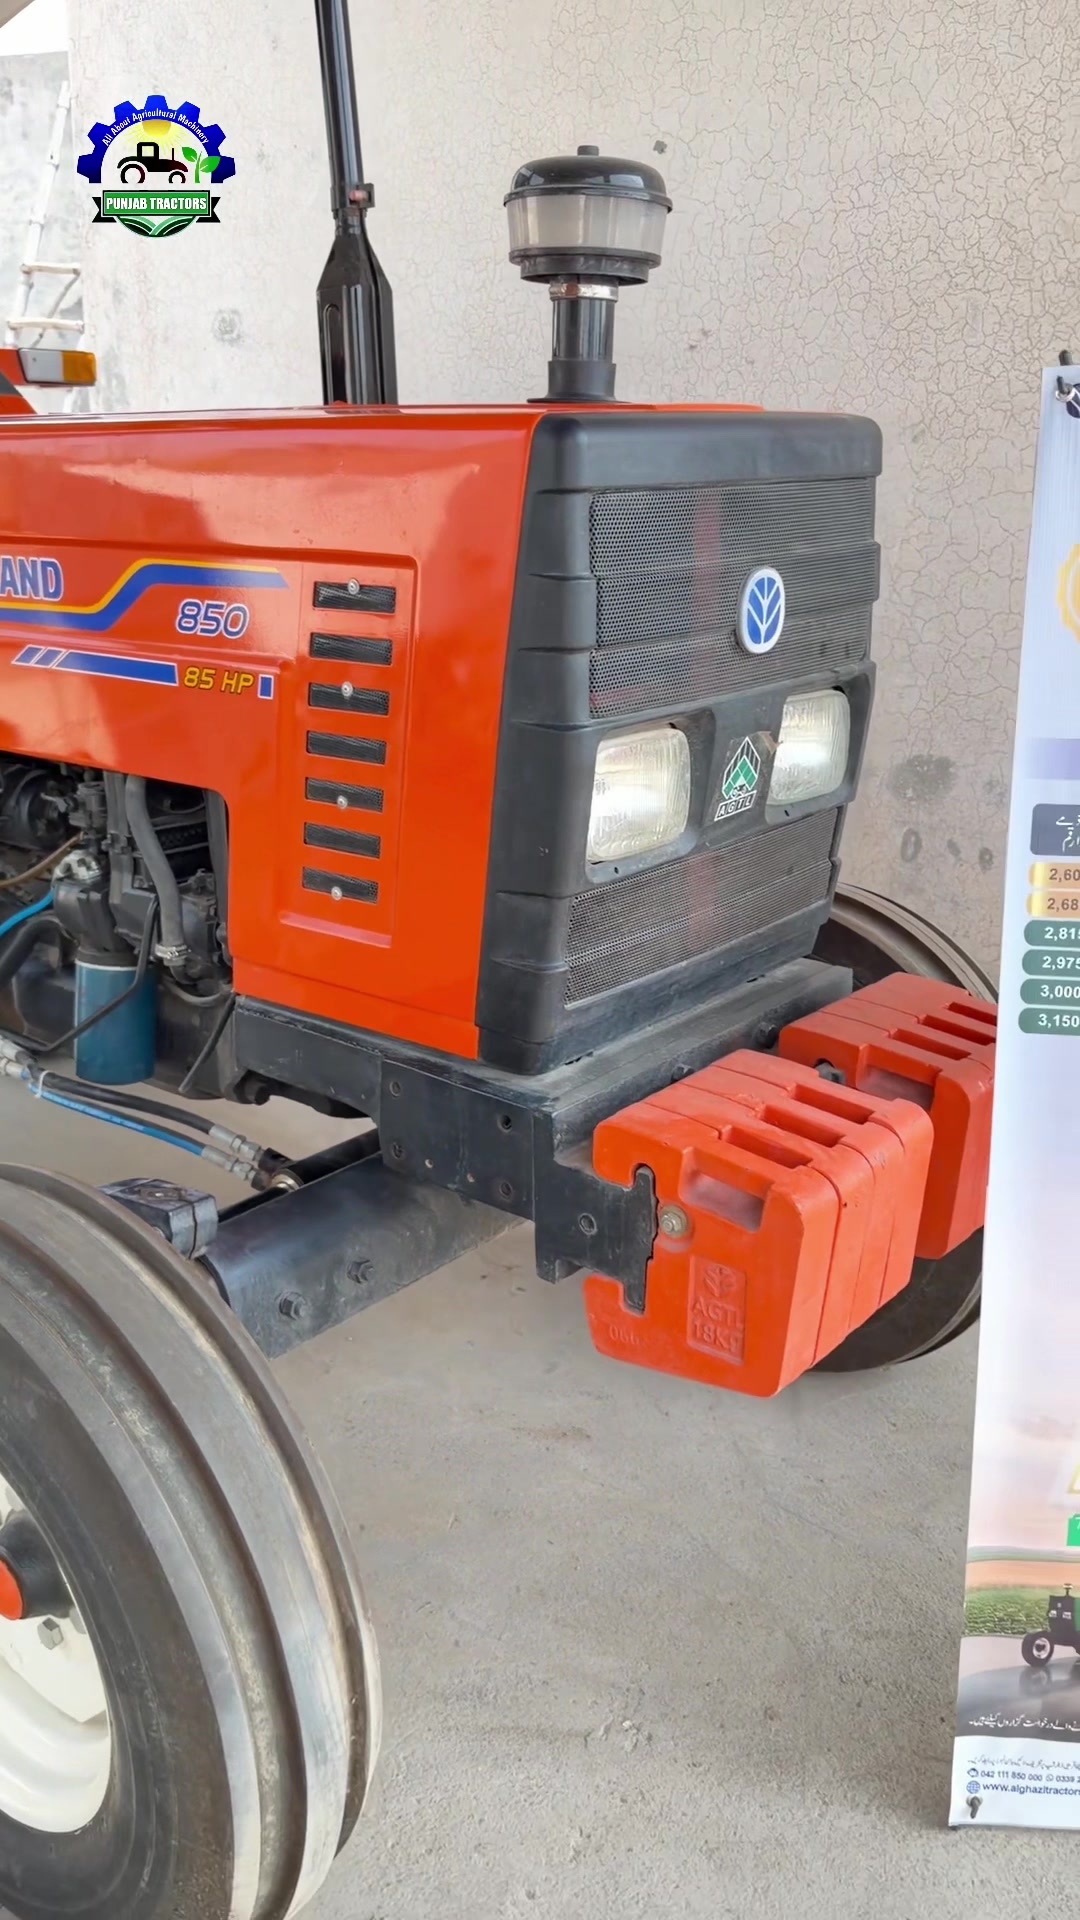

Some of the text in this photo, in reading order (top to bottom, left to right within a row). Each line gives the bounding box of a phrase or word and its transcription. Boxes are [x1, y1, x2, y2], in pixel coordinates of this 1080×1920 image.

[0, 554, 64, 601] AND
[176, 598, 249, 639] 850
[183, 666, 256, 695] 85 HP
[718, 796, 752, 817] AGTL
[1037, 1013, 1080, 1029] 3,150
